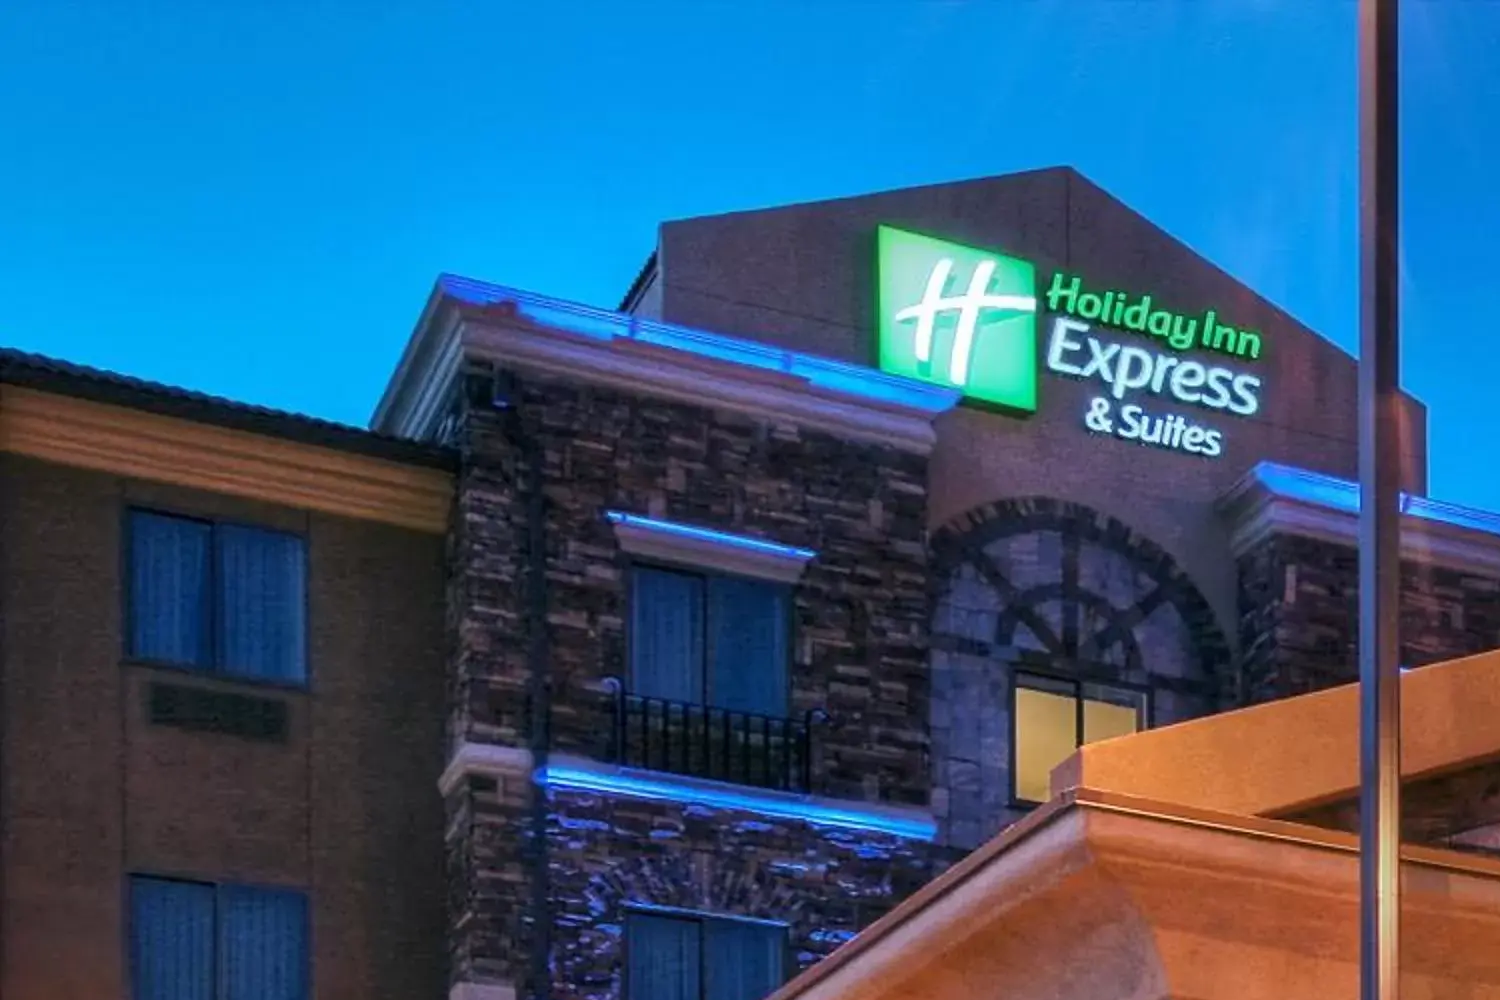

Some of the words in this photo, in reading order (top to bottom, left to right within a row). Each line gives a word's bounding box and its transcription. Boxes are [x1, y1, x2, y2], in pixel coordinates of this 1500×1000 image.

[1046, 273, 1197, 349] Holiday
[1202, 311, 1261, 359] Inn
[1047, 316, 1261, 415] Express
[1085, 397, 1113, 433] &
[1118, 405, 1222, 457] Suites
